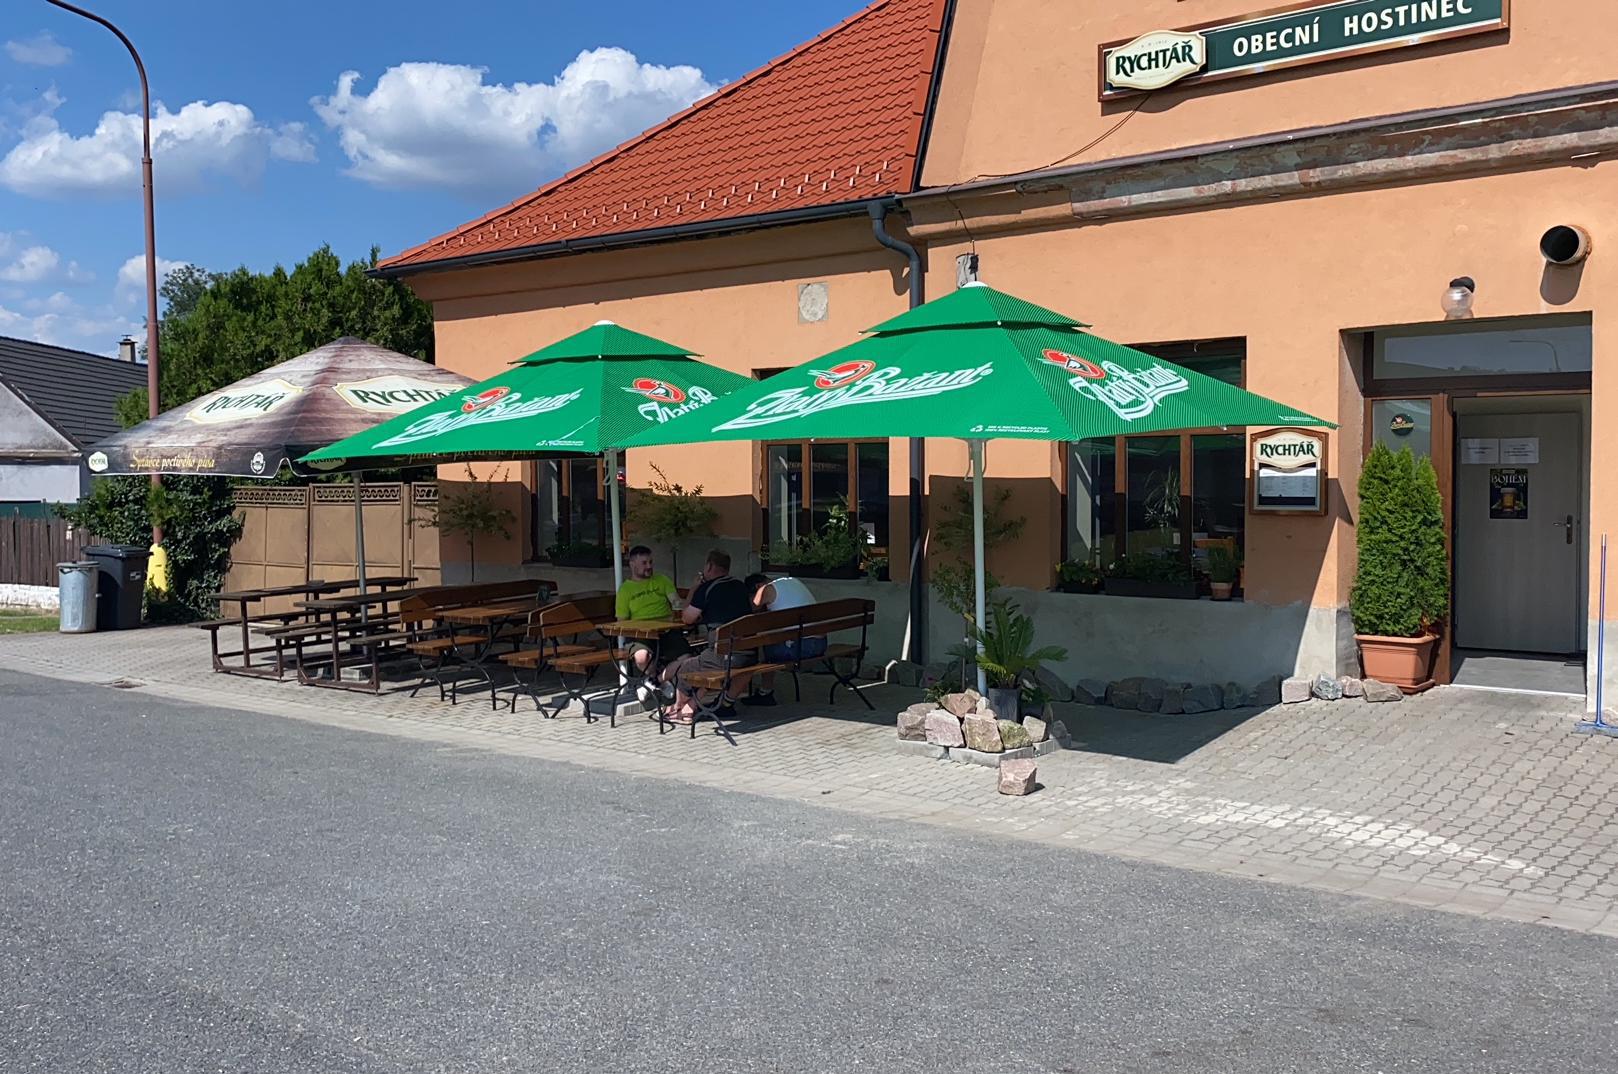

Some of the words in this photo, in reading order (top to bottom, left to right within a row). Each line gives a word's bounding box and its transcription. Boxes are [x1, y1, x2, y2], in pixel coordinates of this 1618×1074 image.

[1233, 17, 1320, 57] OBECNÍ
[1344, 0, 1473, 37] HOSTINEC
[1115, 40, 1198, 77] RYCHTÁŘ
[201, 392, 289, 413] RYCHTÁŘ
[1260, 441, 1317, 458] RYCHTÁŘ
